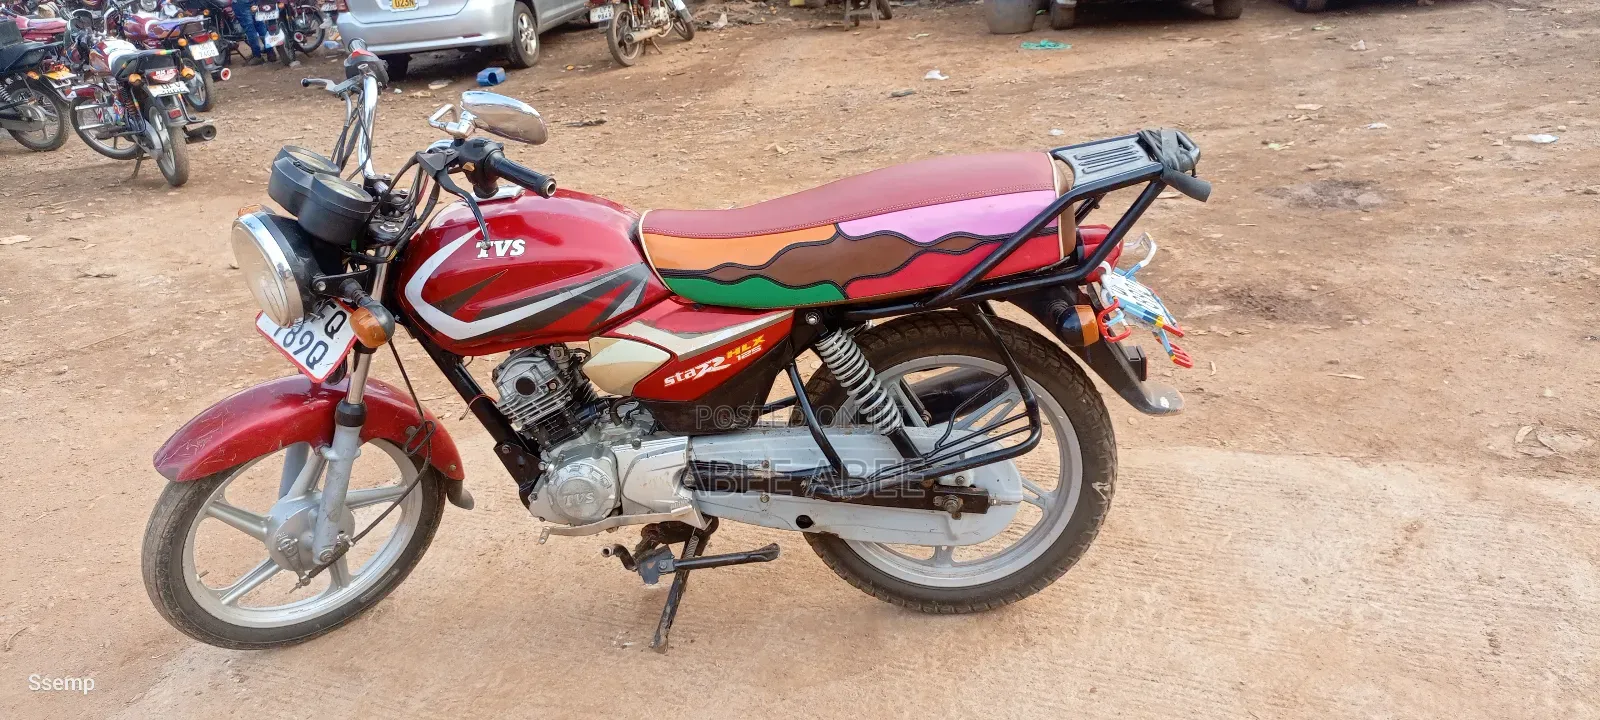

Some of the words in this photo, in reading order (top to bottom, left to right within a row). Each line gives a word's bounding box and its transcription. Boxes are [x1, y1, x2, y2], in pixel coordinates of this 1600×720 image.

[475, 239, 526, 258] TVS
[726, 334, 766, 359] HLX
[736, 345, 762, 361] 125
[563, 493, 595, 507] TVS
